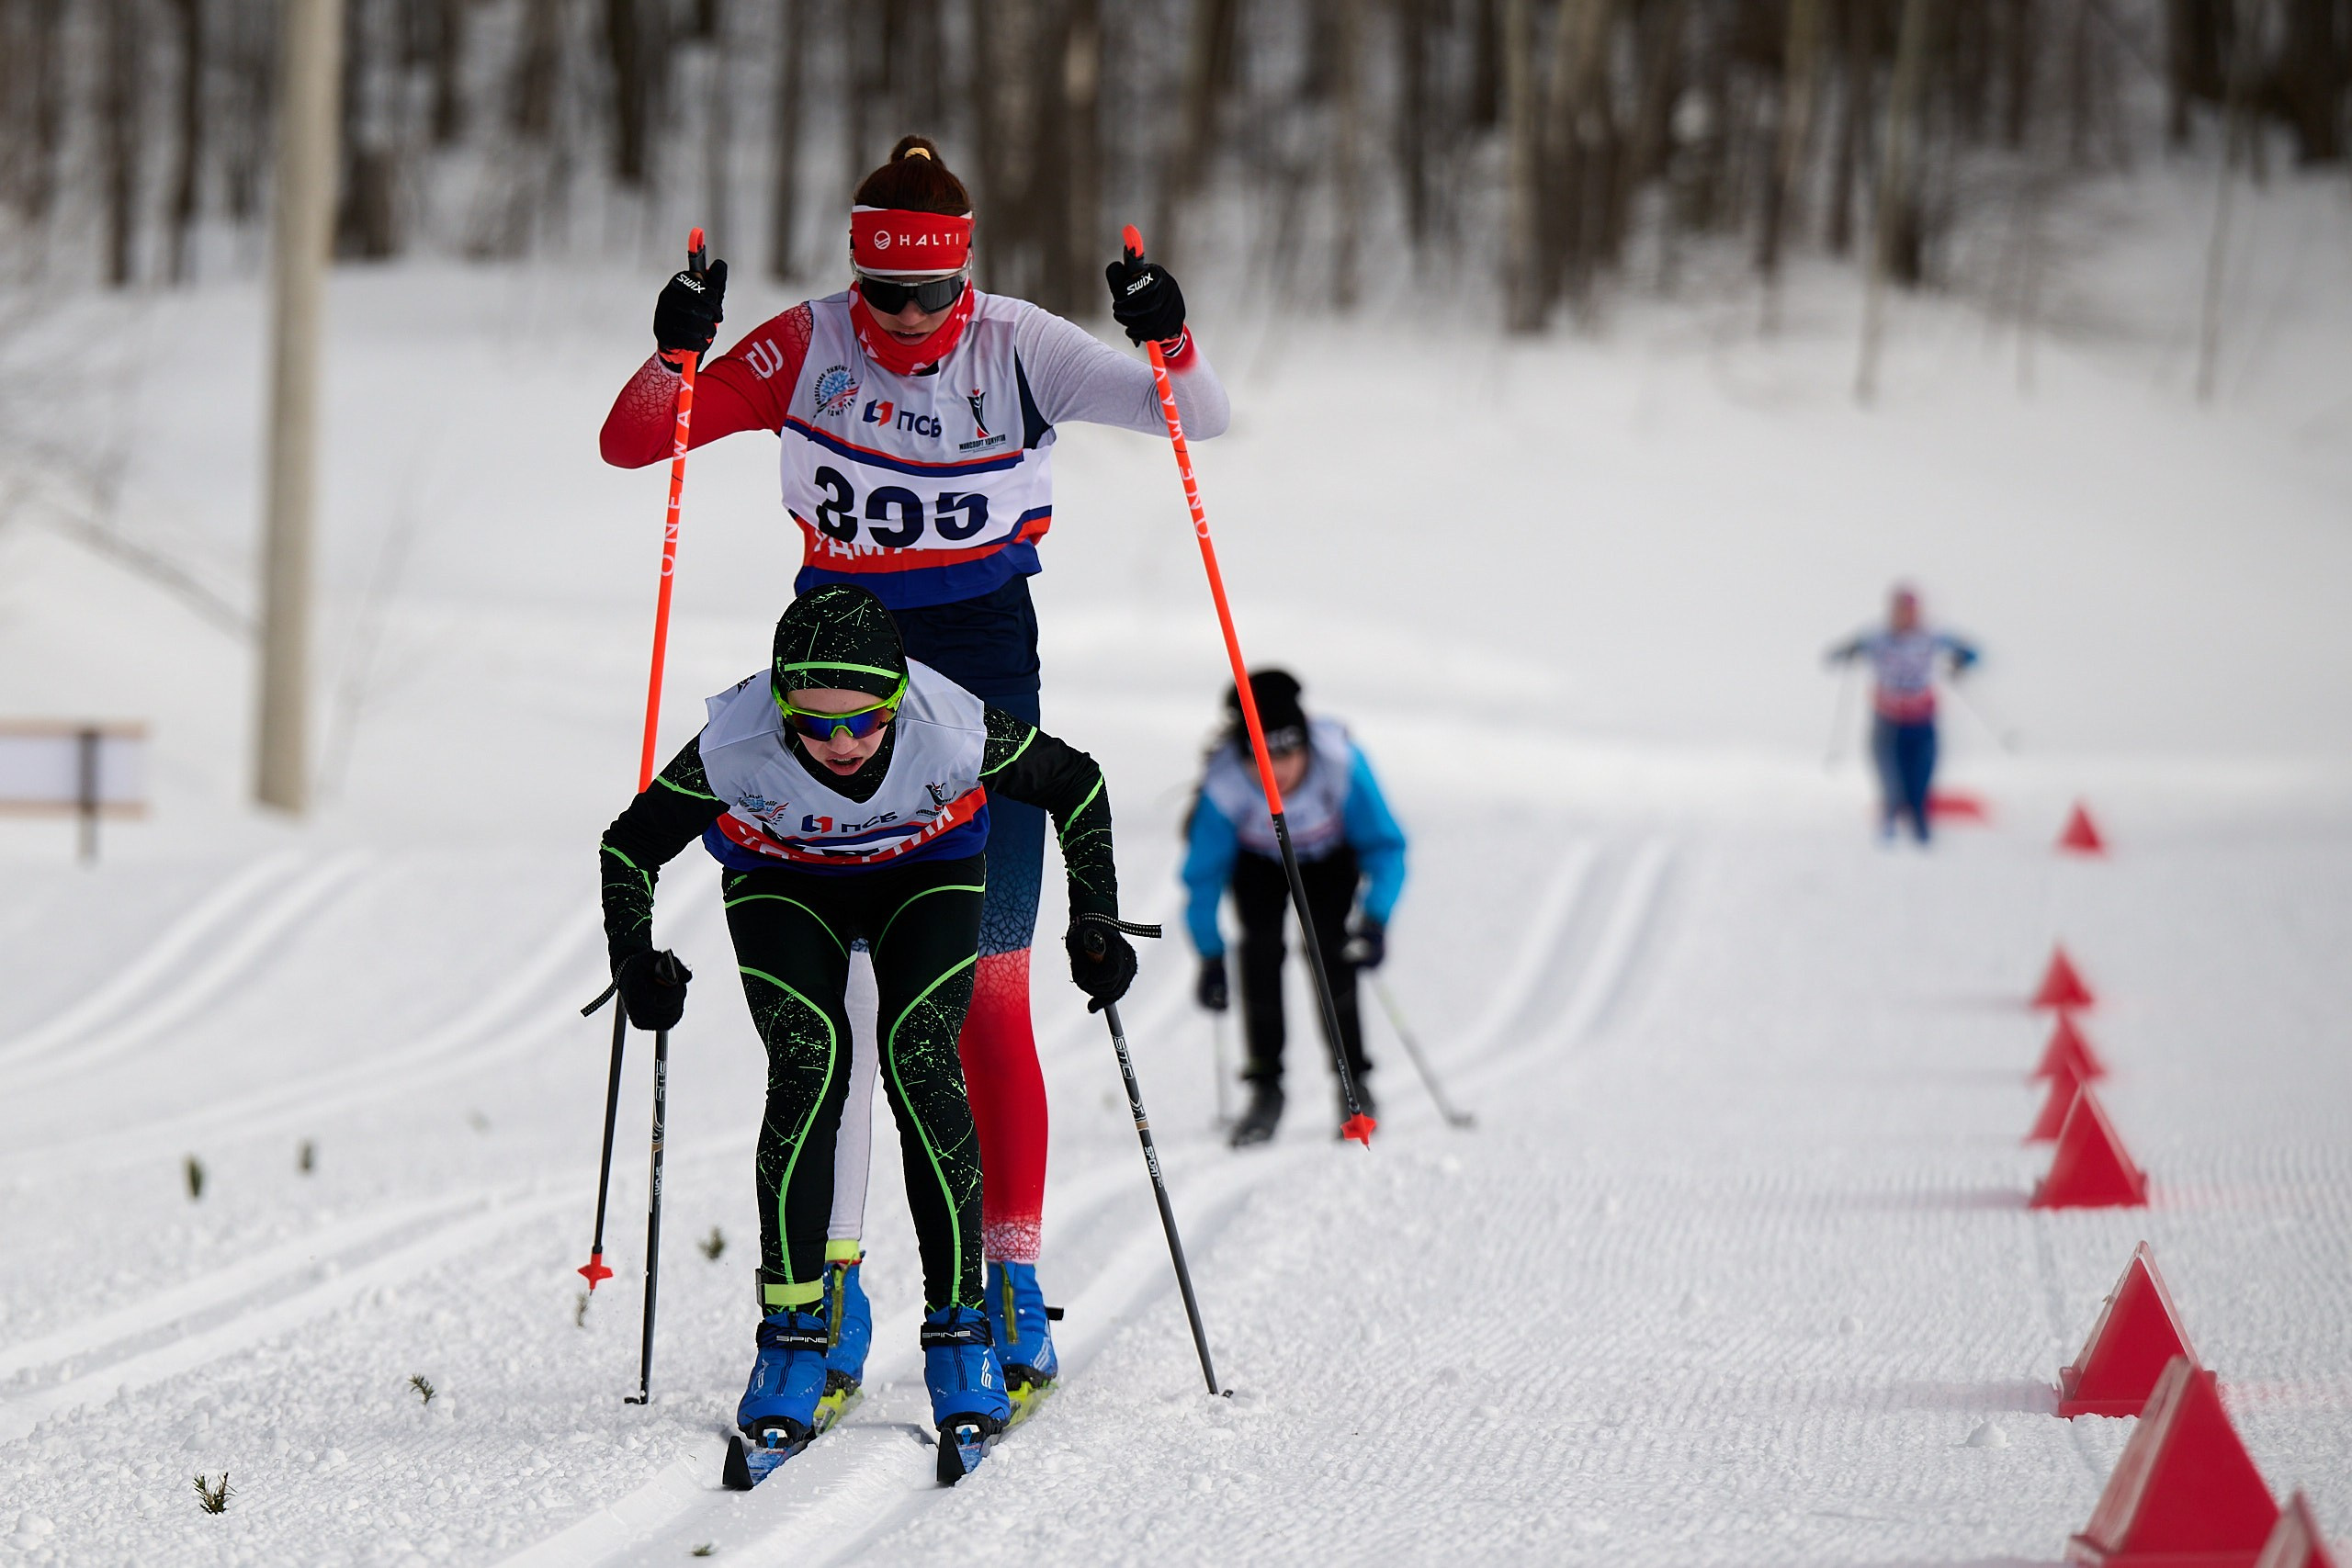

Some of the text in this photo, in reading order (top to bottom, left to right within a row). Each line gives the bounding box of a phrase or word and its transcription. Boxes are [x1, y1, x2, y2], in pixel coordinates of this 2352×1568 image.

[899, 232, 960, 247] HALTI
[896, 410, 943, 438] ПСБ
[661, 379, 695, 577] ONE WAY
[1113, 1036, 1135, 1078] STC
[1144, 1145, 1160, 1179] SPORT
[775, 1335, 828, 1344] SPINE
[922, 1330, 971, 1338] SPINE
